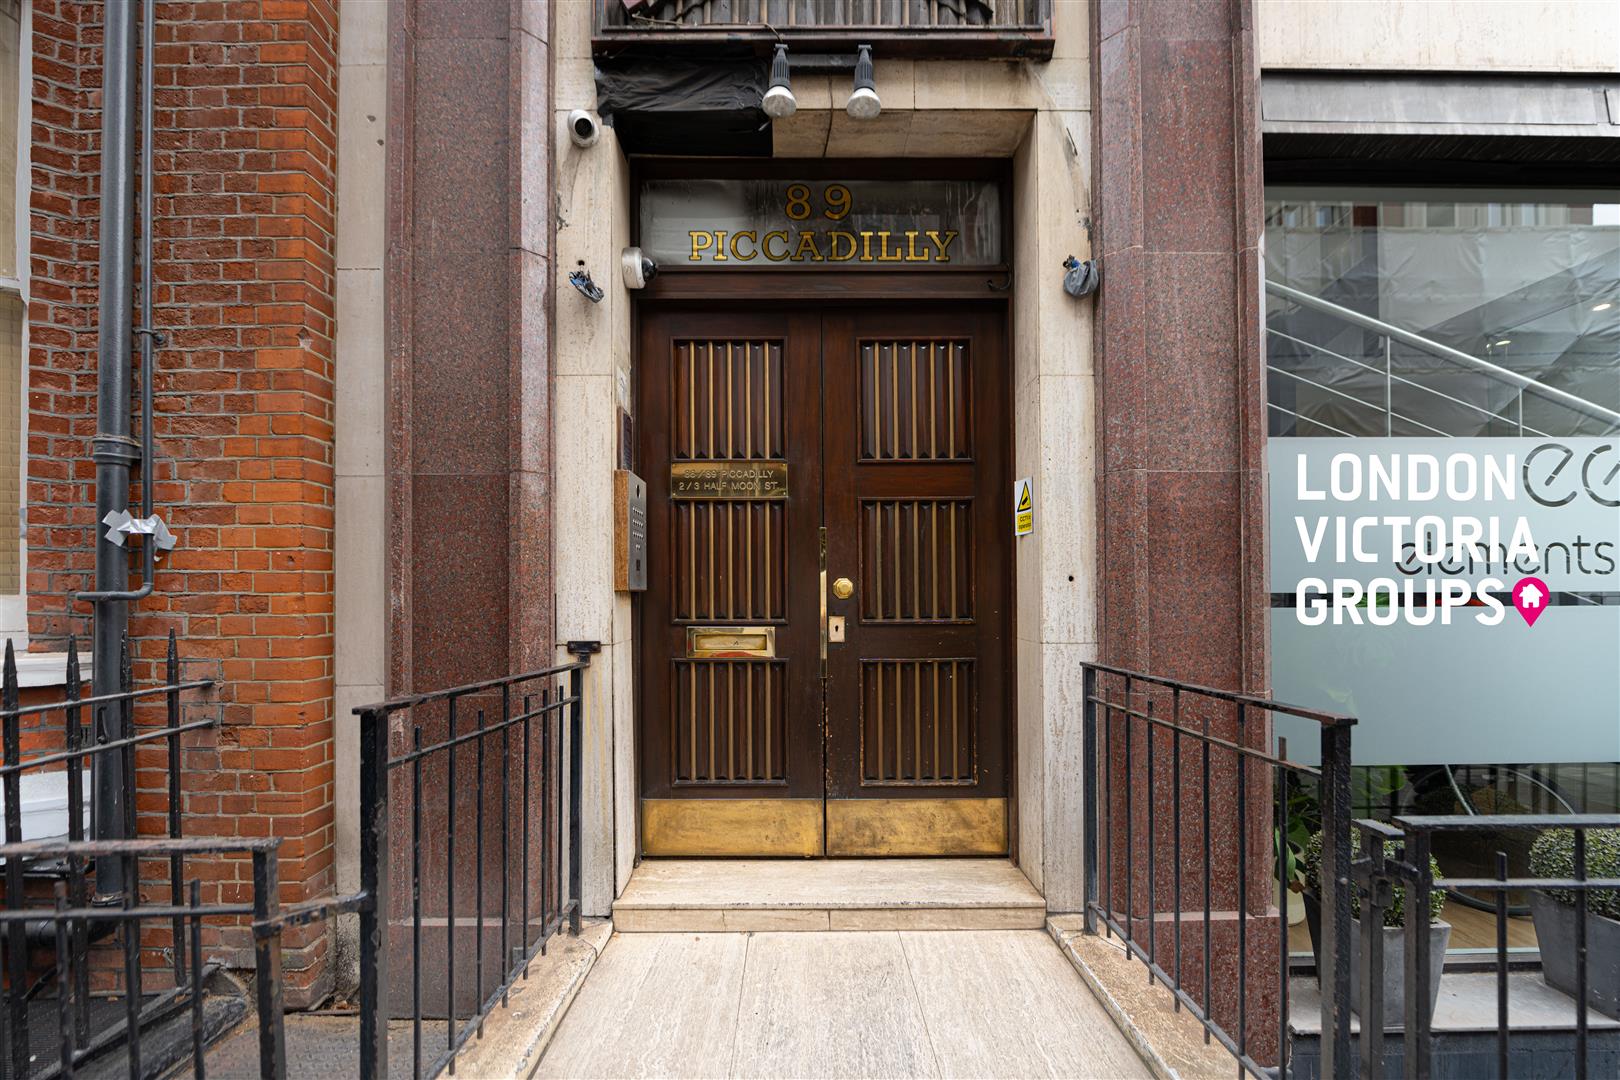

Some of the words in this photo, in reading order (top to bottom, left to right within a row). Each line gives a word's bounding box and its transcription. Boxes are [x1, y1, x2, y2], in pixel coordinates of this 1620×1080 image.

[785, 184, 852, 220] 89
[688, 230, 959, 262] PICCADILLY
[721, 470, 774, 479] PICCADILLY
[679, 481, 700, 491] 2/3
[704, 481, 727, 491] HALF
[731, 481, 759, 491] MOON
